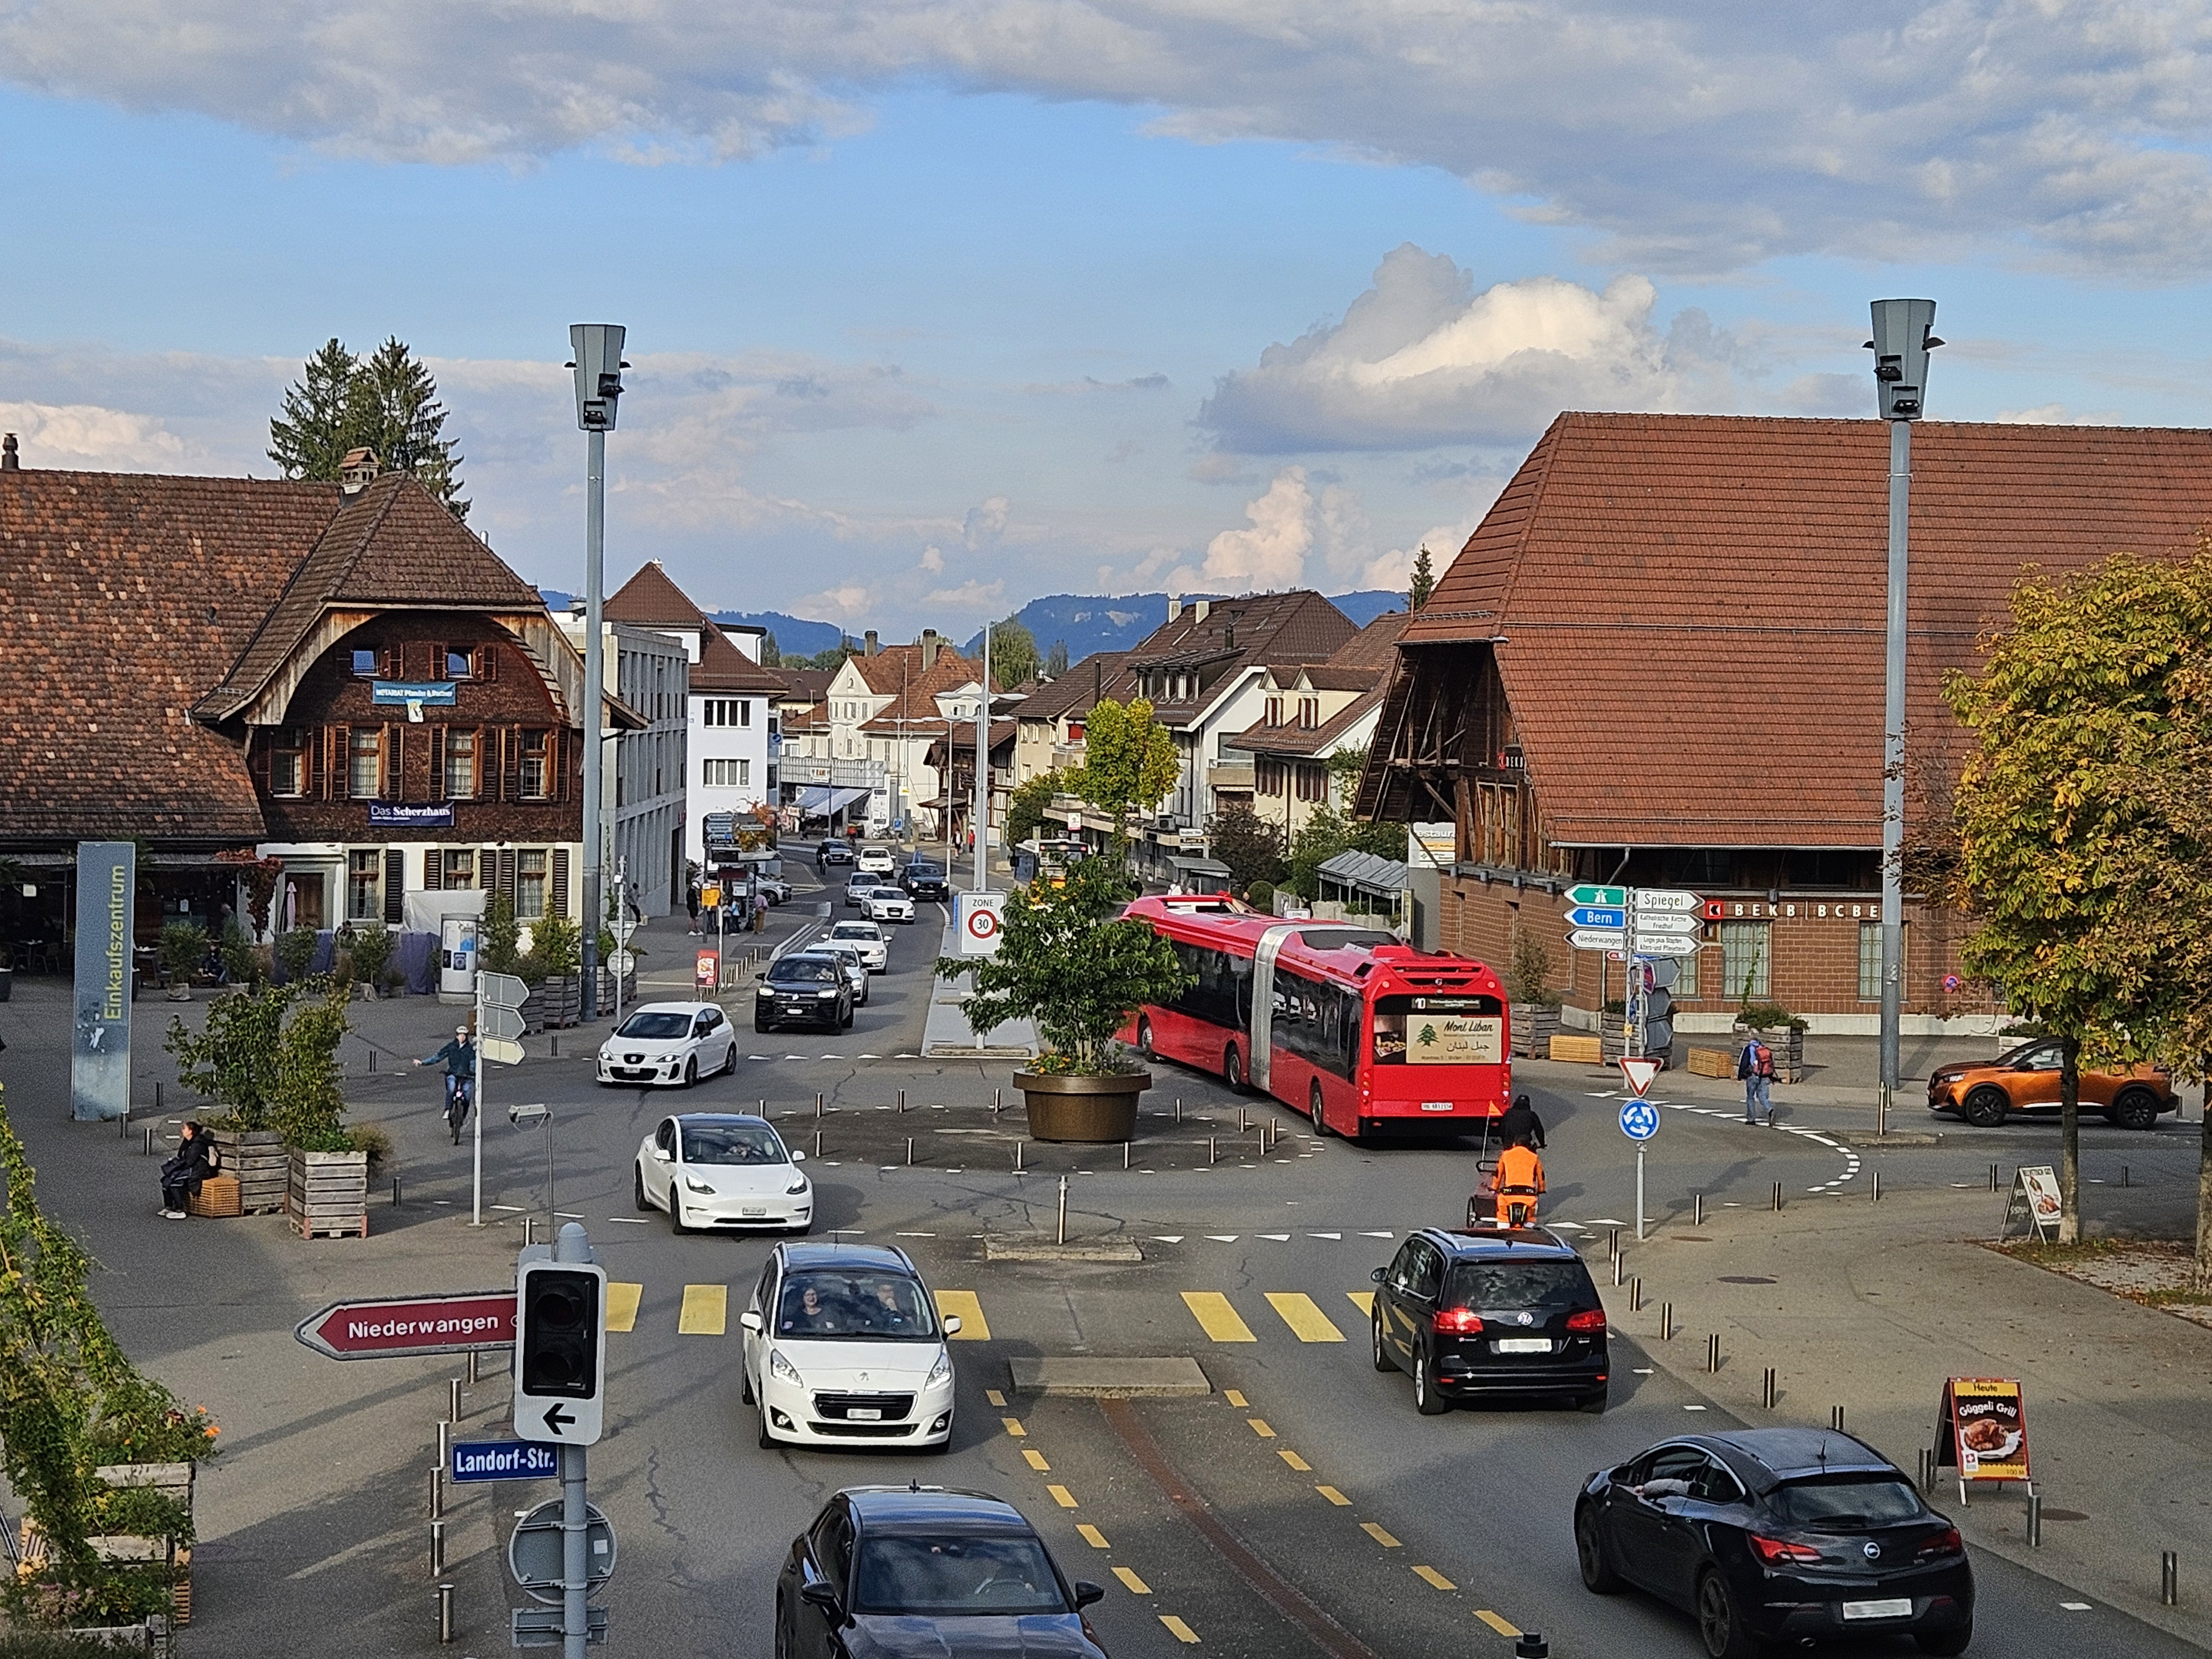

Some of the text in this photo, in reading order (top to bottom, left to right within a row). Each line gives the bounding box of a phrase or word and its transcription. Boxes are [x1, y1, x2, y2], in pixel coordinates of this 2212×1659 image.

[371, 806, 451, 816] Das Scherzhaus
[972, 899, 994, 907] ZONE
[1644, 893, 1683, 910] Spiegel
[1734, 903, 1878, 919] BEKB BCBE
[1587, 911, 1613, 924] Bern
[977, 919, 989, 930] 30
[104, 864, 126, 1020] Einkaufszentrum
[1578, 934, 1623, 946] Niederwangen
[1415, 997, 1426, 1009] 10
[1444, 1020, 1494, 1032] Mont Liban
[1446, 1041, 1468, 1052] لبنان
[348, 1314, 499, 1339] Niederwangen
[1974, 1383, 1998, 1392] Heute
[1959, 1400, 2017, 1418] Güggeli Grill
[456, 1447, 555, 1473] Landorf-Str.
